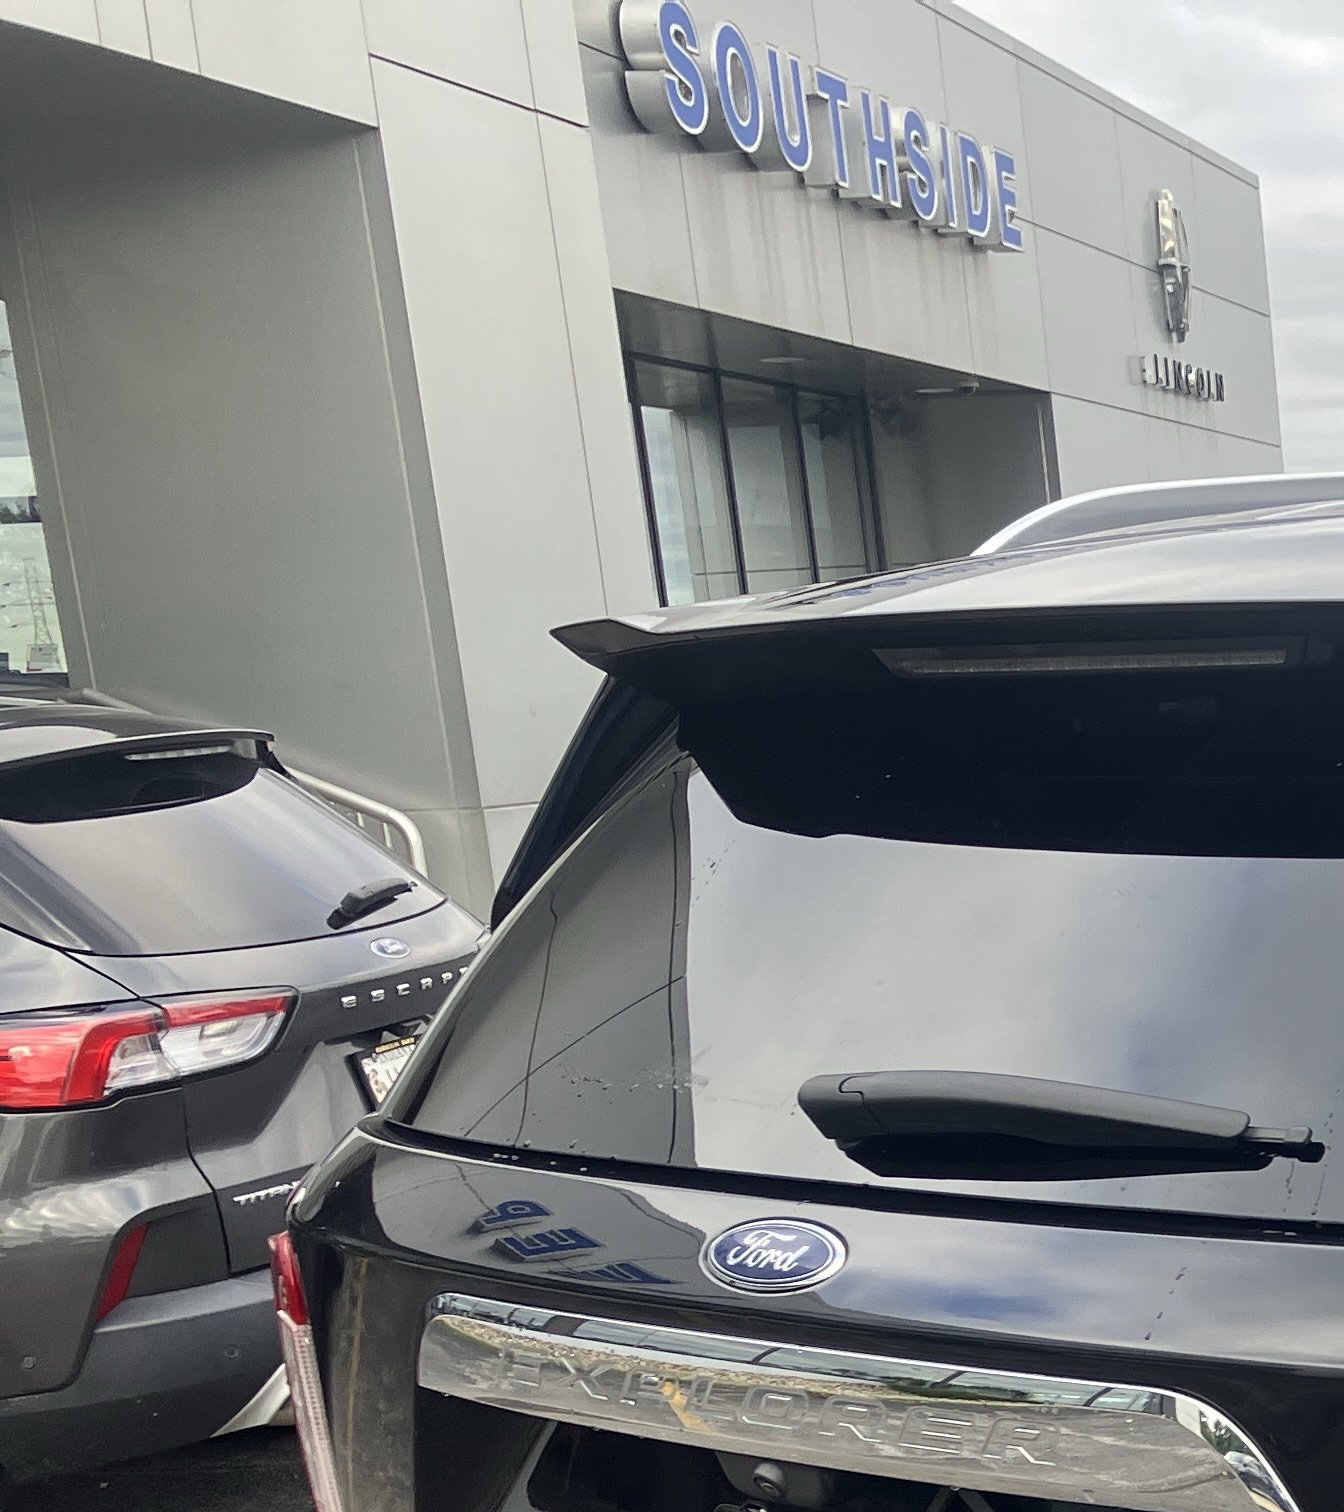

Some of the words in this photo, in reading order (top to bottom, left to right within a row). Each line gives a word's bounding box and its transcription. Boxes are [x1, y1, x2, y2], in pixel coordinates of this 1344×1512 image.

[652, 0, 1025, 253] SOUTHSIDE
[1148, 353, 1225, 403] LINCOLN
[725, 1229, 811, 1272] Ford
[498, 1349, 1061, 1467] EXPLORER
